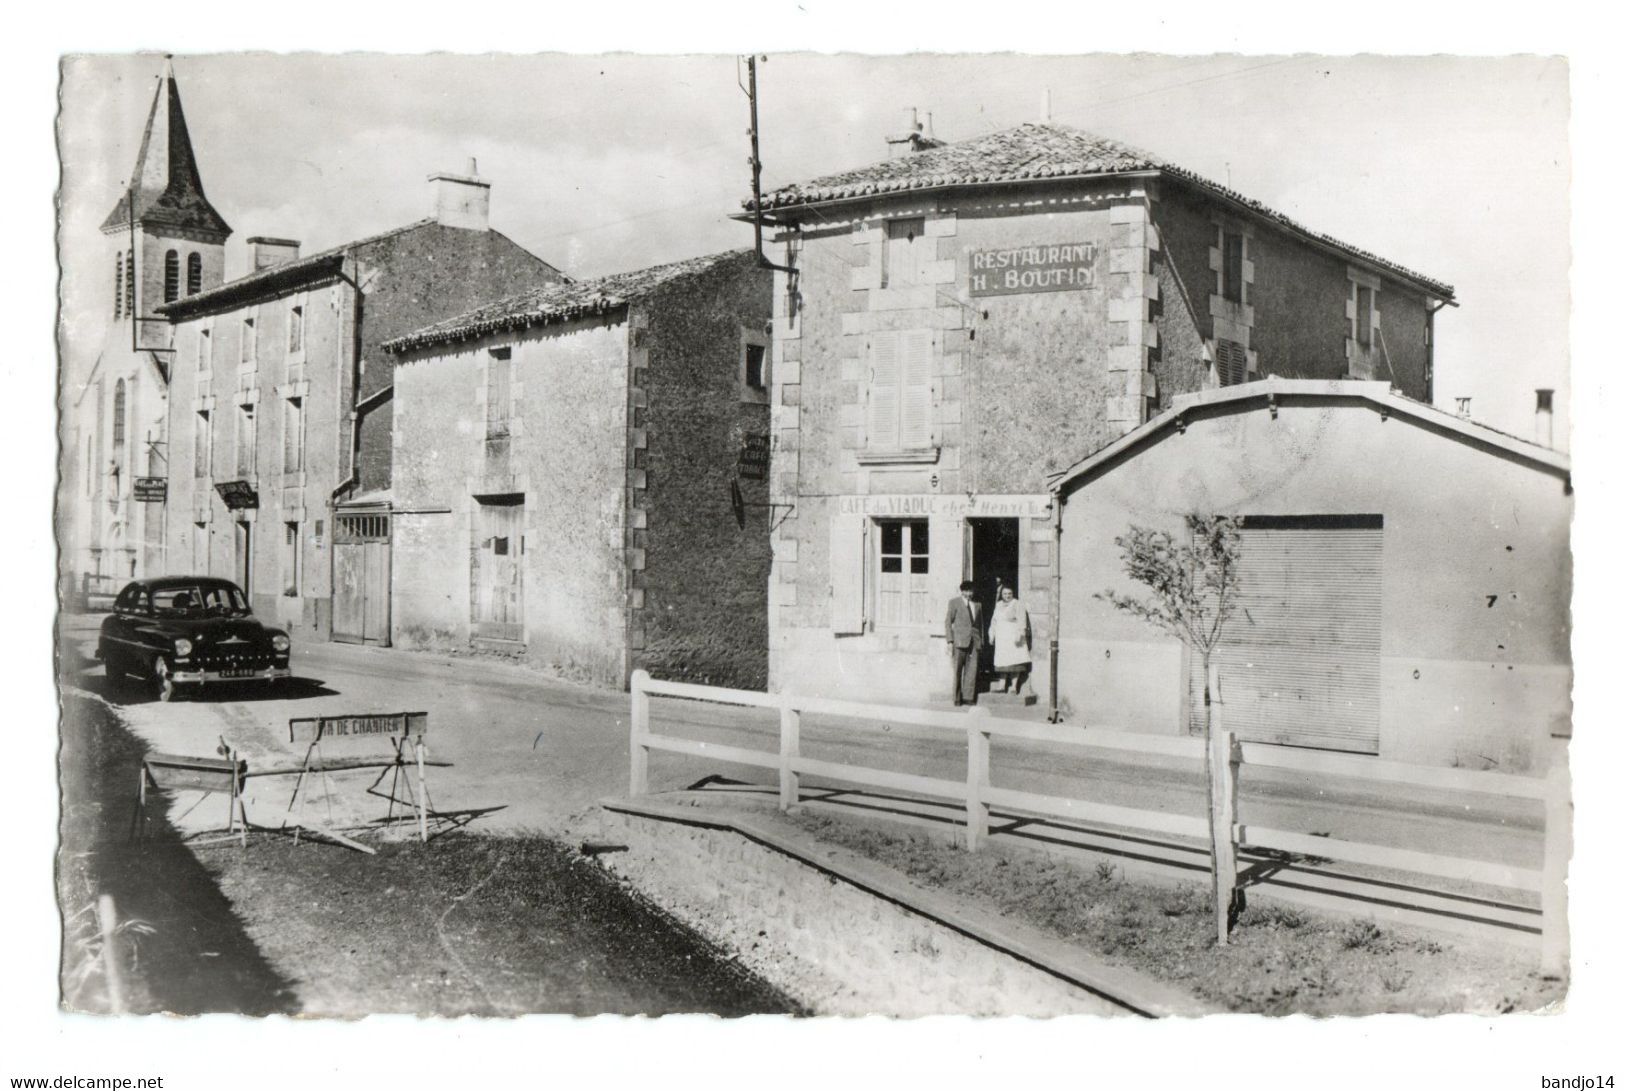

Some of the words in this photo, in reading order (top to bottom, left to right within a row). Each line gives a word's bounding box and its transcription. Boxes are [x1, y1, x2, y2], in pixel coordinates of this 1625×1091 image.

[973, 244, 1095, 270] RESTAURANT
[1004, 266, 1097, 289] BOUTIN
[888, 496, 937, 514] VIADUC
[336, 719, 350, 736] DE
[352, 716, 400, 735] CHANTIER
